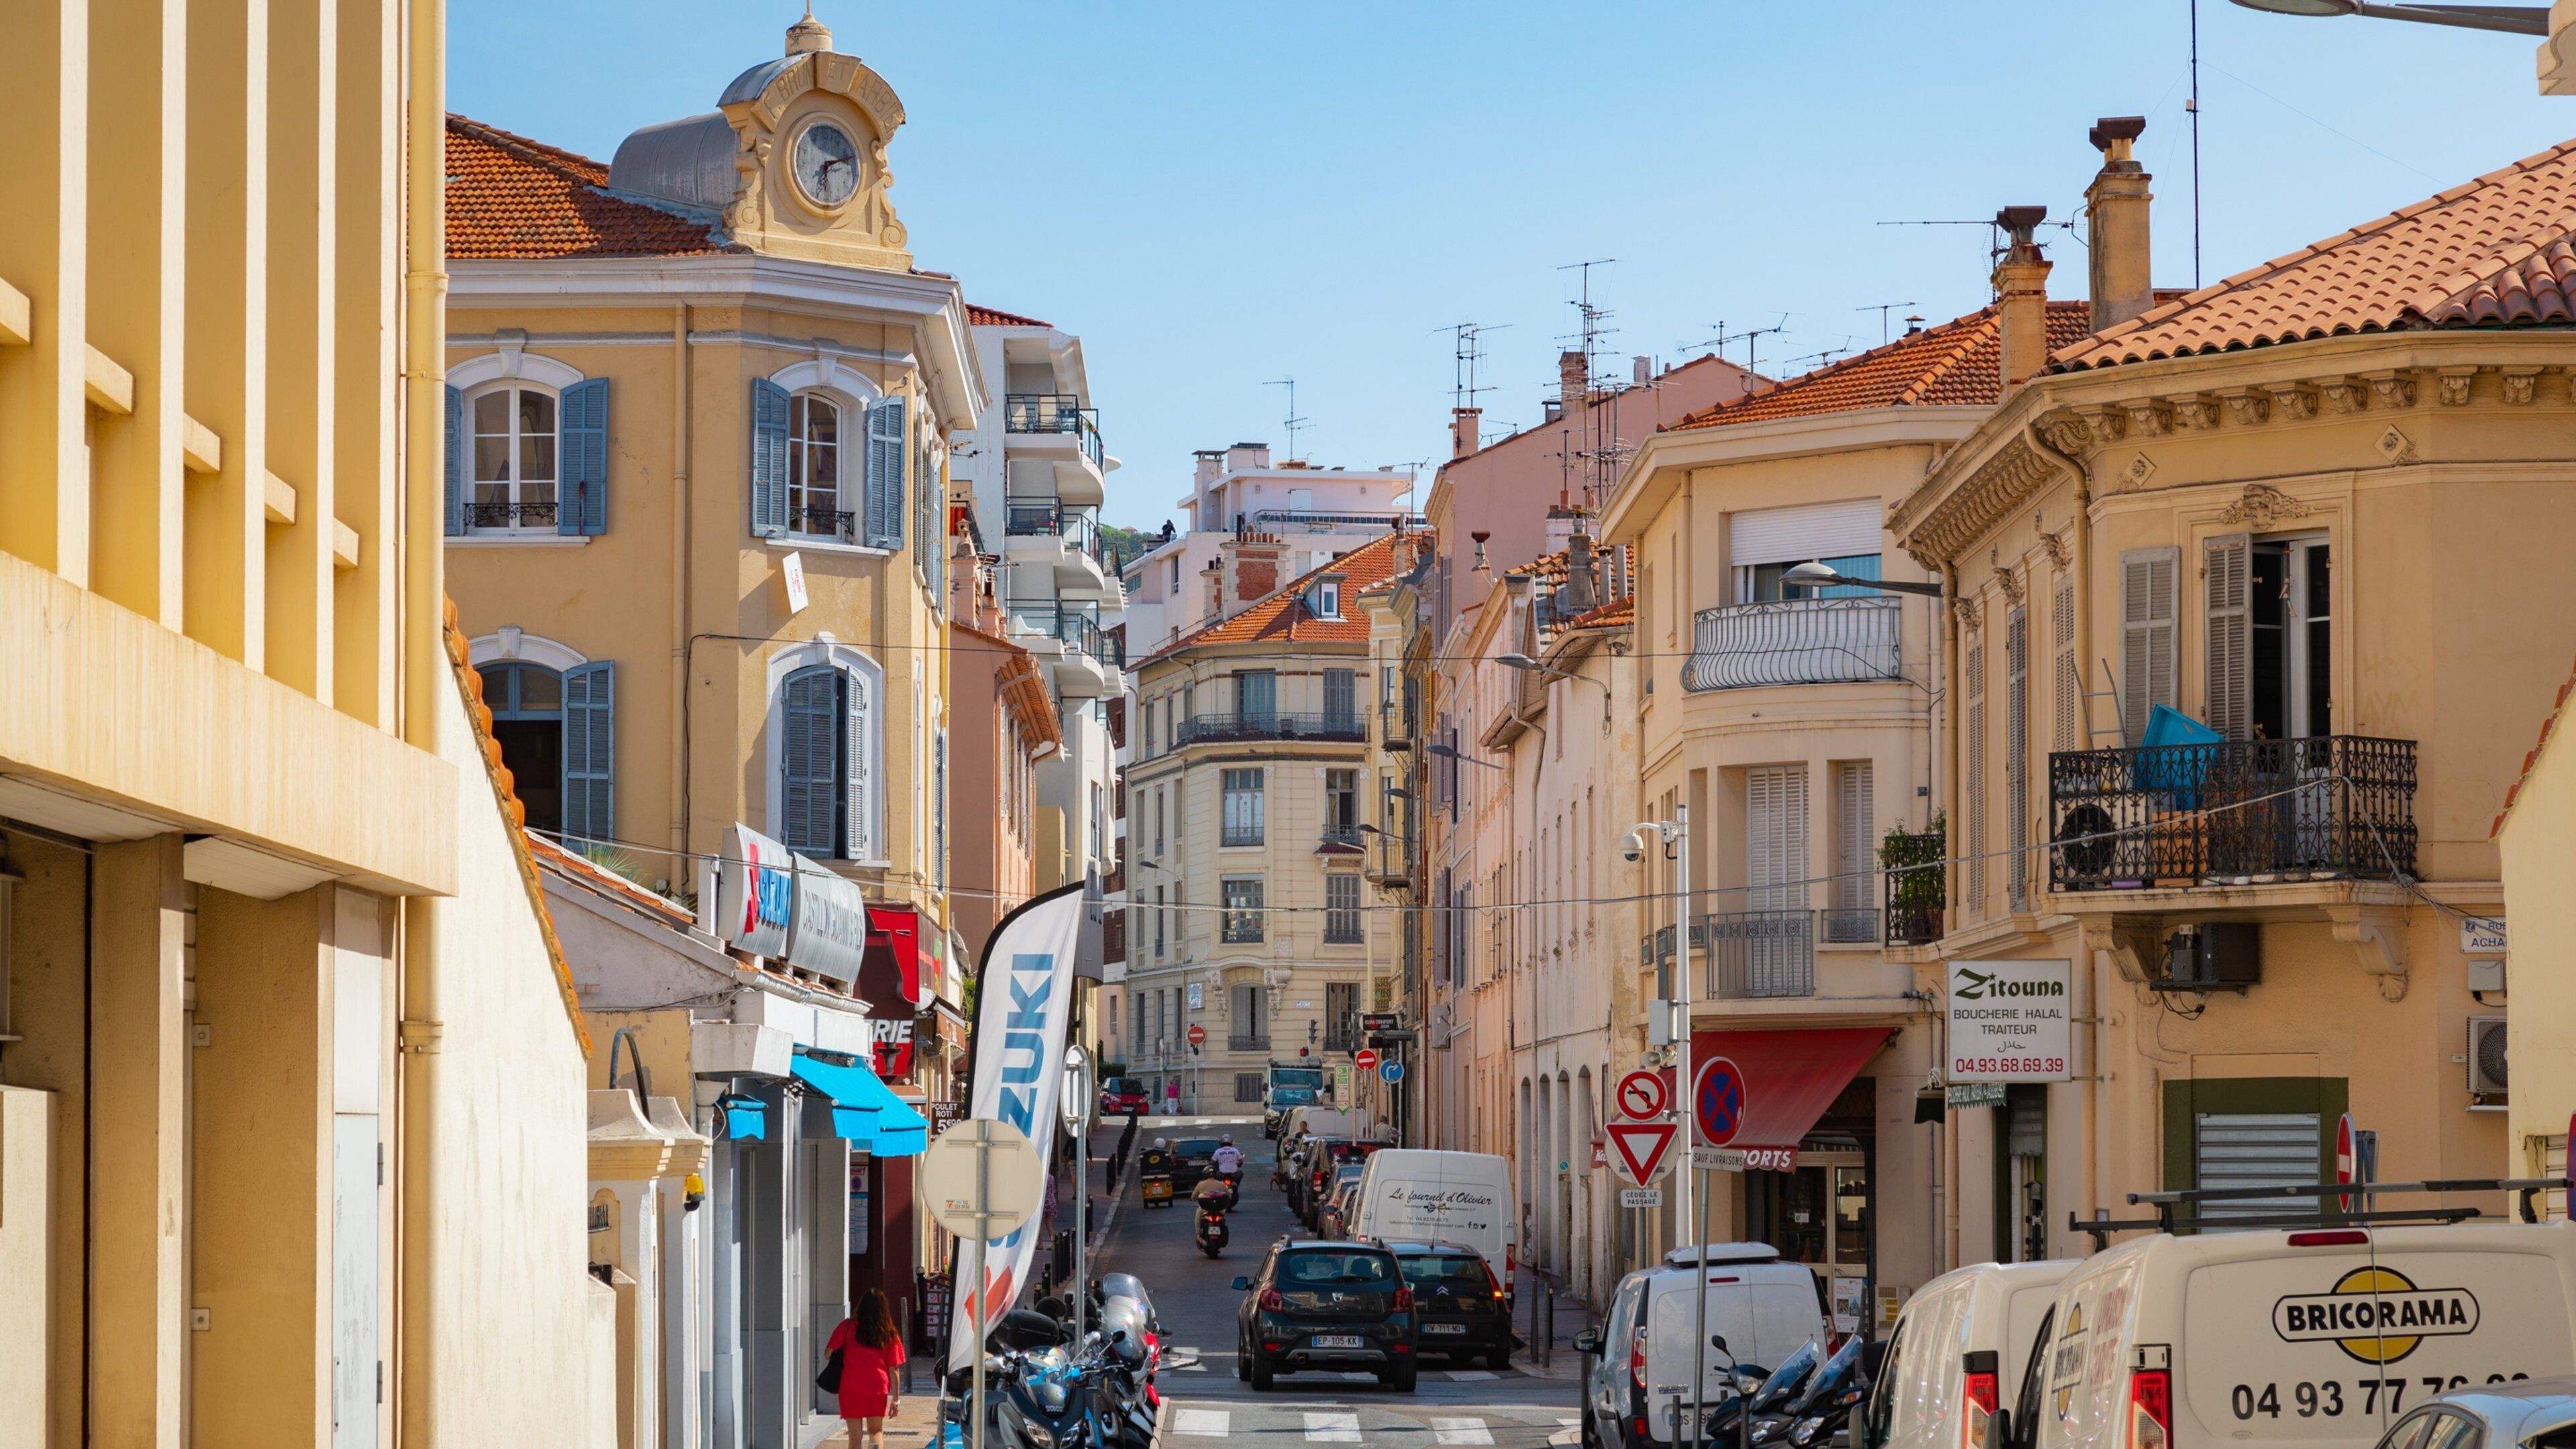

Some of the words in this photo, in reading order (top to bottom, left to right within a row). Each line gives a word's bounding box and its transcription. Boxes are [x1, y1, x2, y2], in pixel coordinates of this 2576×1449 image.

[826, 54, 849, 80] ET
[2471, 938, 2507, 947] ACHA
[1953, 968, 2063, 1000] Zitouna
[1954, 1009, 2019, 1019] BOUCHERIE
[2025, 1009, 2062, 1018] HALAL
[872, 1020, 914, 1043] RIE
[1981, 1024, 2037, 1034] TRAITEUR
[1997, 1041, 2026, 1053] حلال
[1955, 1059, 2063, 1072] 04.93.68.69.39
[1694, 1152, 1709, 1163] SAUF
[1710, 1155, 1743, 1167] LIVRAISONS
[1389, 1187, 1404, 1199] Le
[1407, 1190, 1445, 1203] fournil
[1446, 1191, 1493, 1205] d'Olivier
[2286, 1298, 2467, 1332] BRICORAMA
[1318, 1336, 1358, 1346] EP-105-KK
[2232, 1383, 2281, 1419] 04
[2295, 1381, 2344, 1417] 93
[2359, 1379, 2406, 1415] 77
